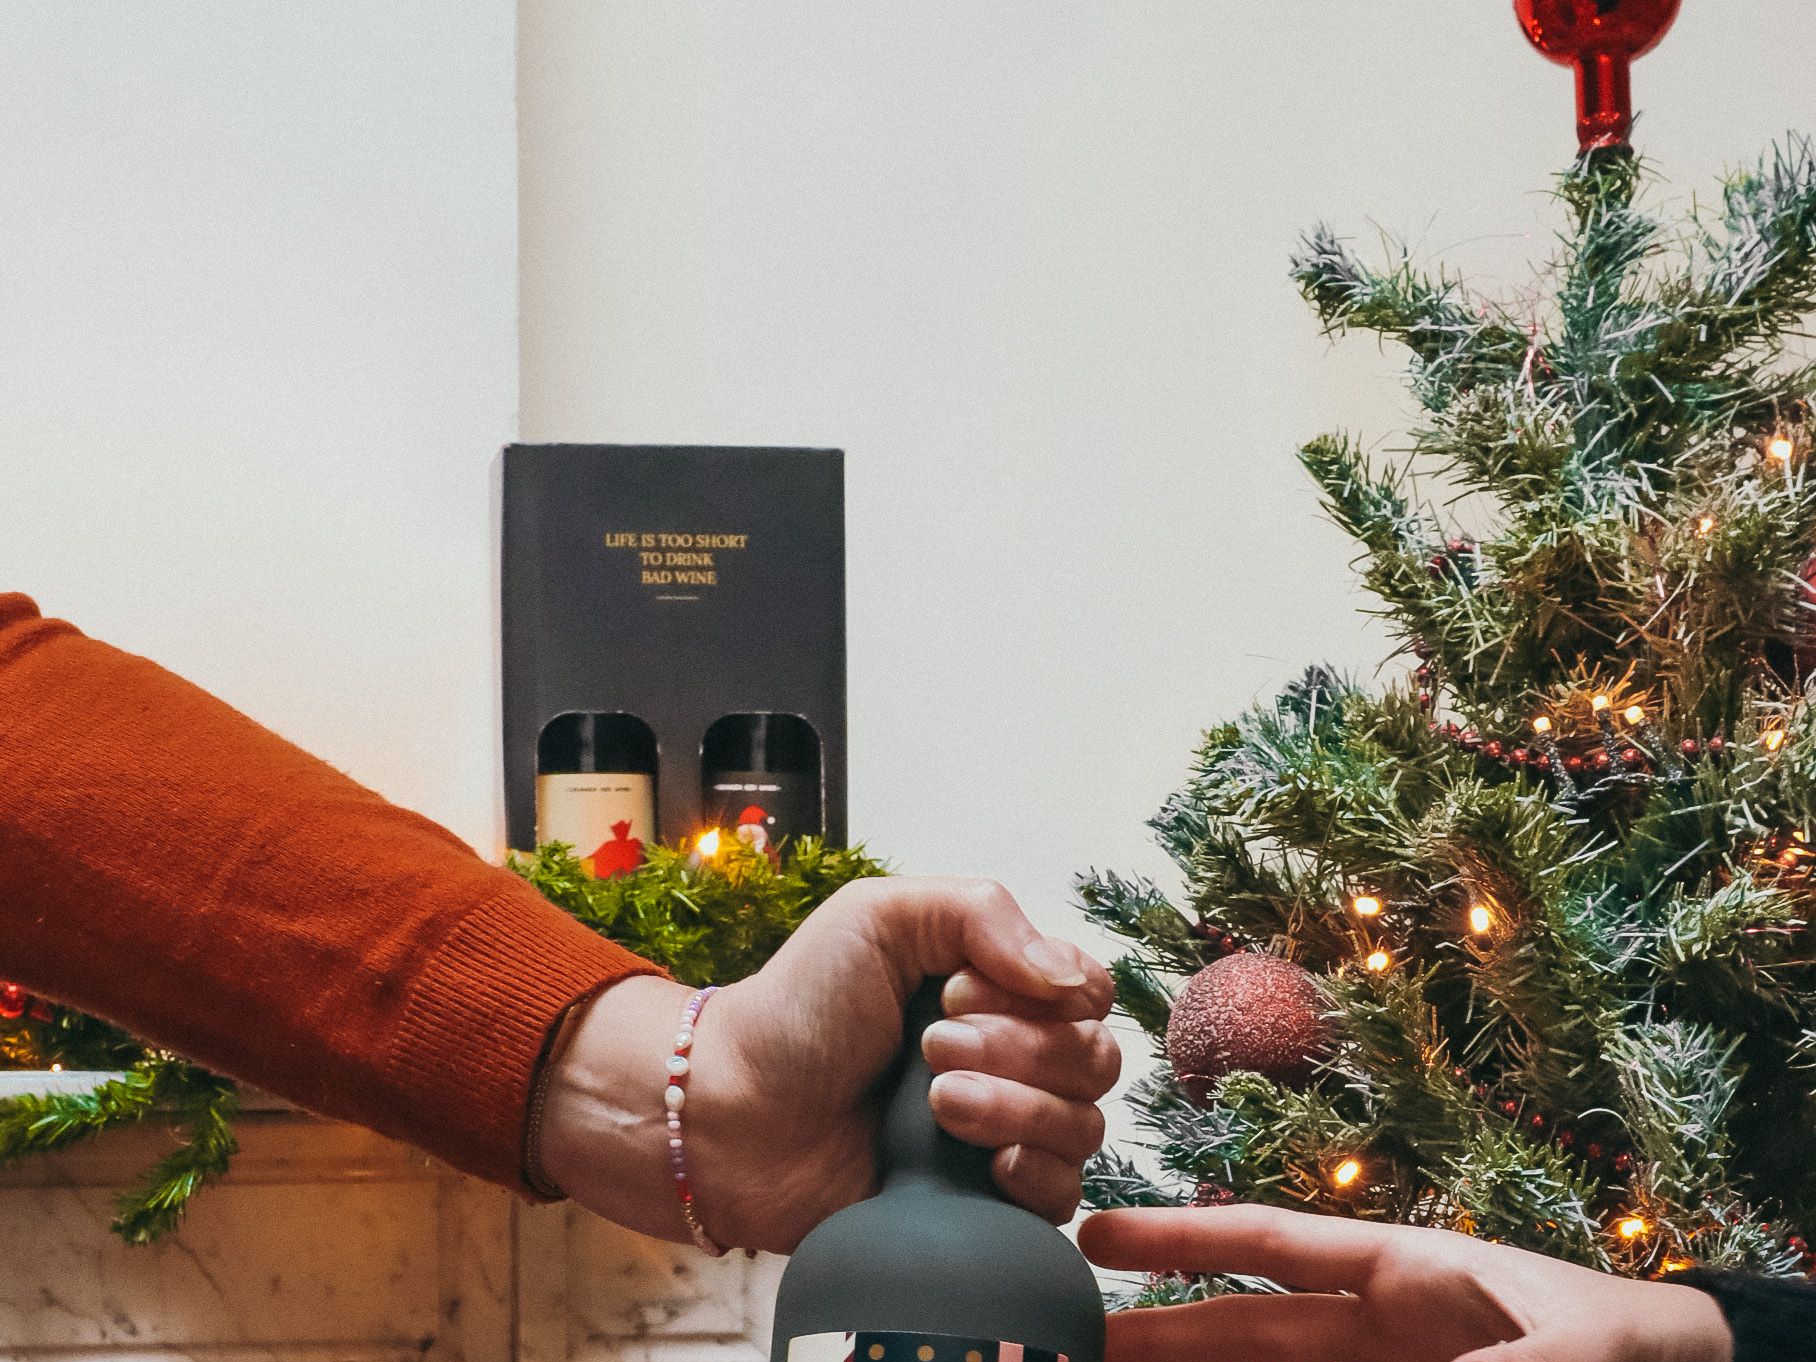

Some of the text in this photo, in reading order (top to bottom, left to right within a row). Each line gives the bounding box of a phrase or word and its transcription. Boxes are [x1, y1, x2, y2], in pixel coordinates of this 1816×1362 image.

[605, 533, 748, 549] LIFE IS TOO SHORT
[640, 552, 716, 567] TO DRINK
[641, 570, 718, 586] BAD WINE
